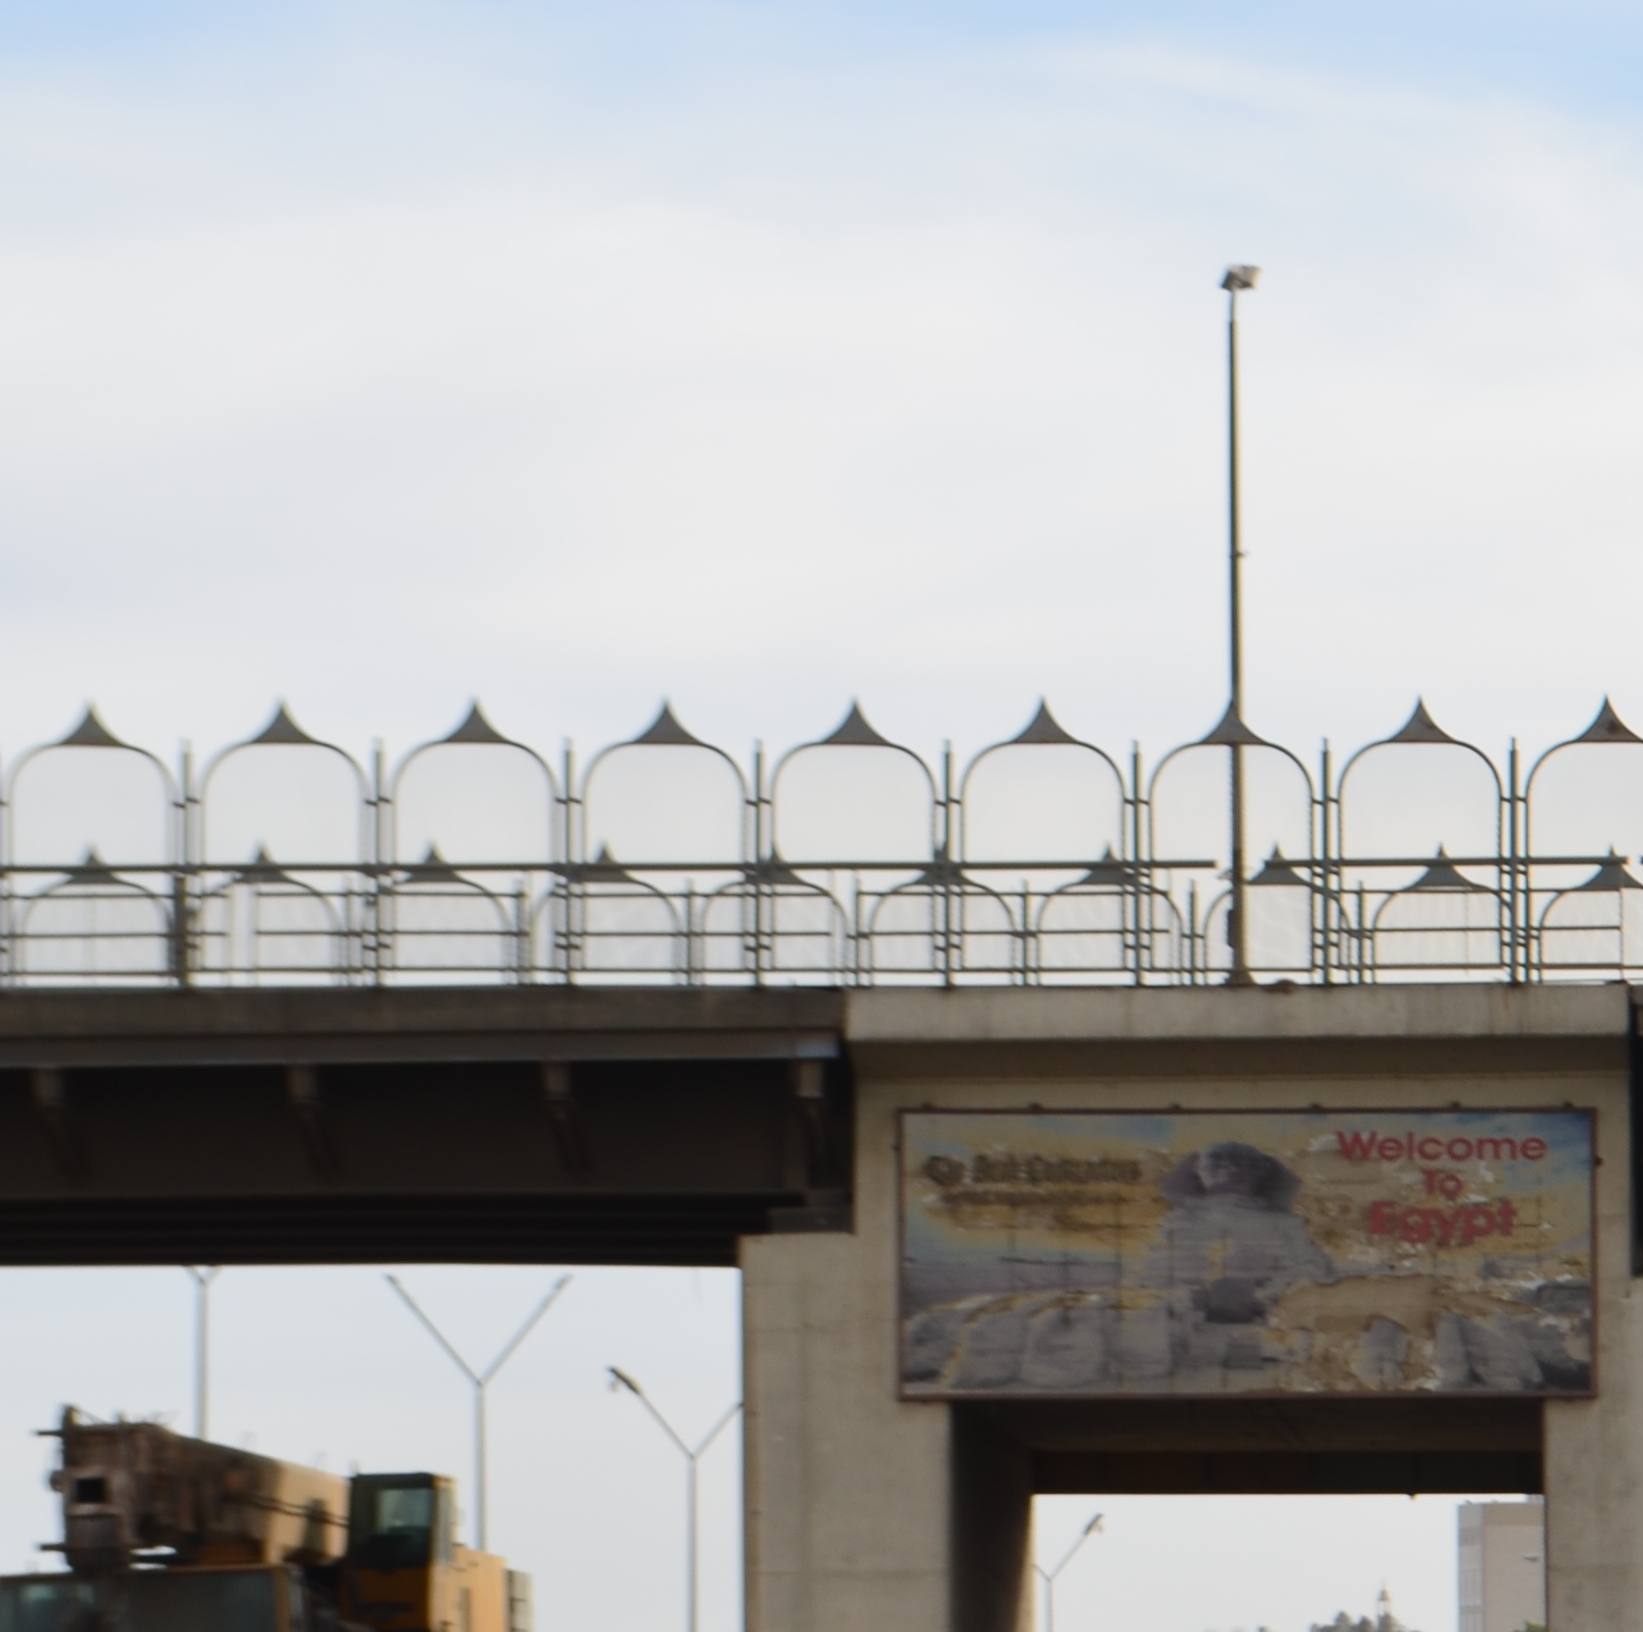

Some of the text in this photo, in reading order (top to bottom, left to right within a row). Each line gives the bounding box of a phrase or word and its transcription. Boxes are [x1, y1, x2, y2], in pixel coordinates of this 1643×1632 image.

[1335, 1129, 1549, 1161] Welcome
[1422, 1168, 1464, 1199] To
[1369, 1199, 1516, 1246] Egypt
